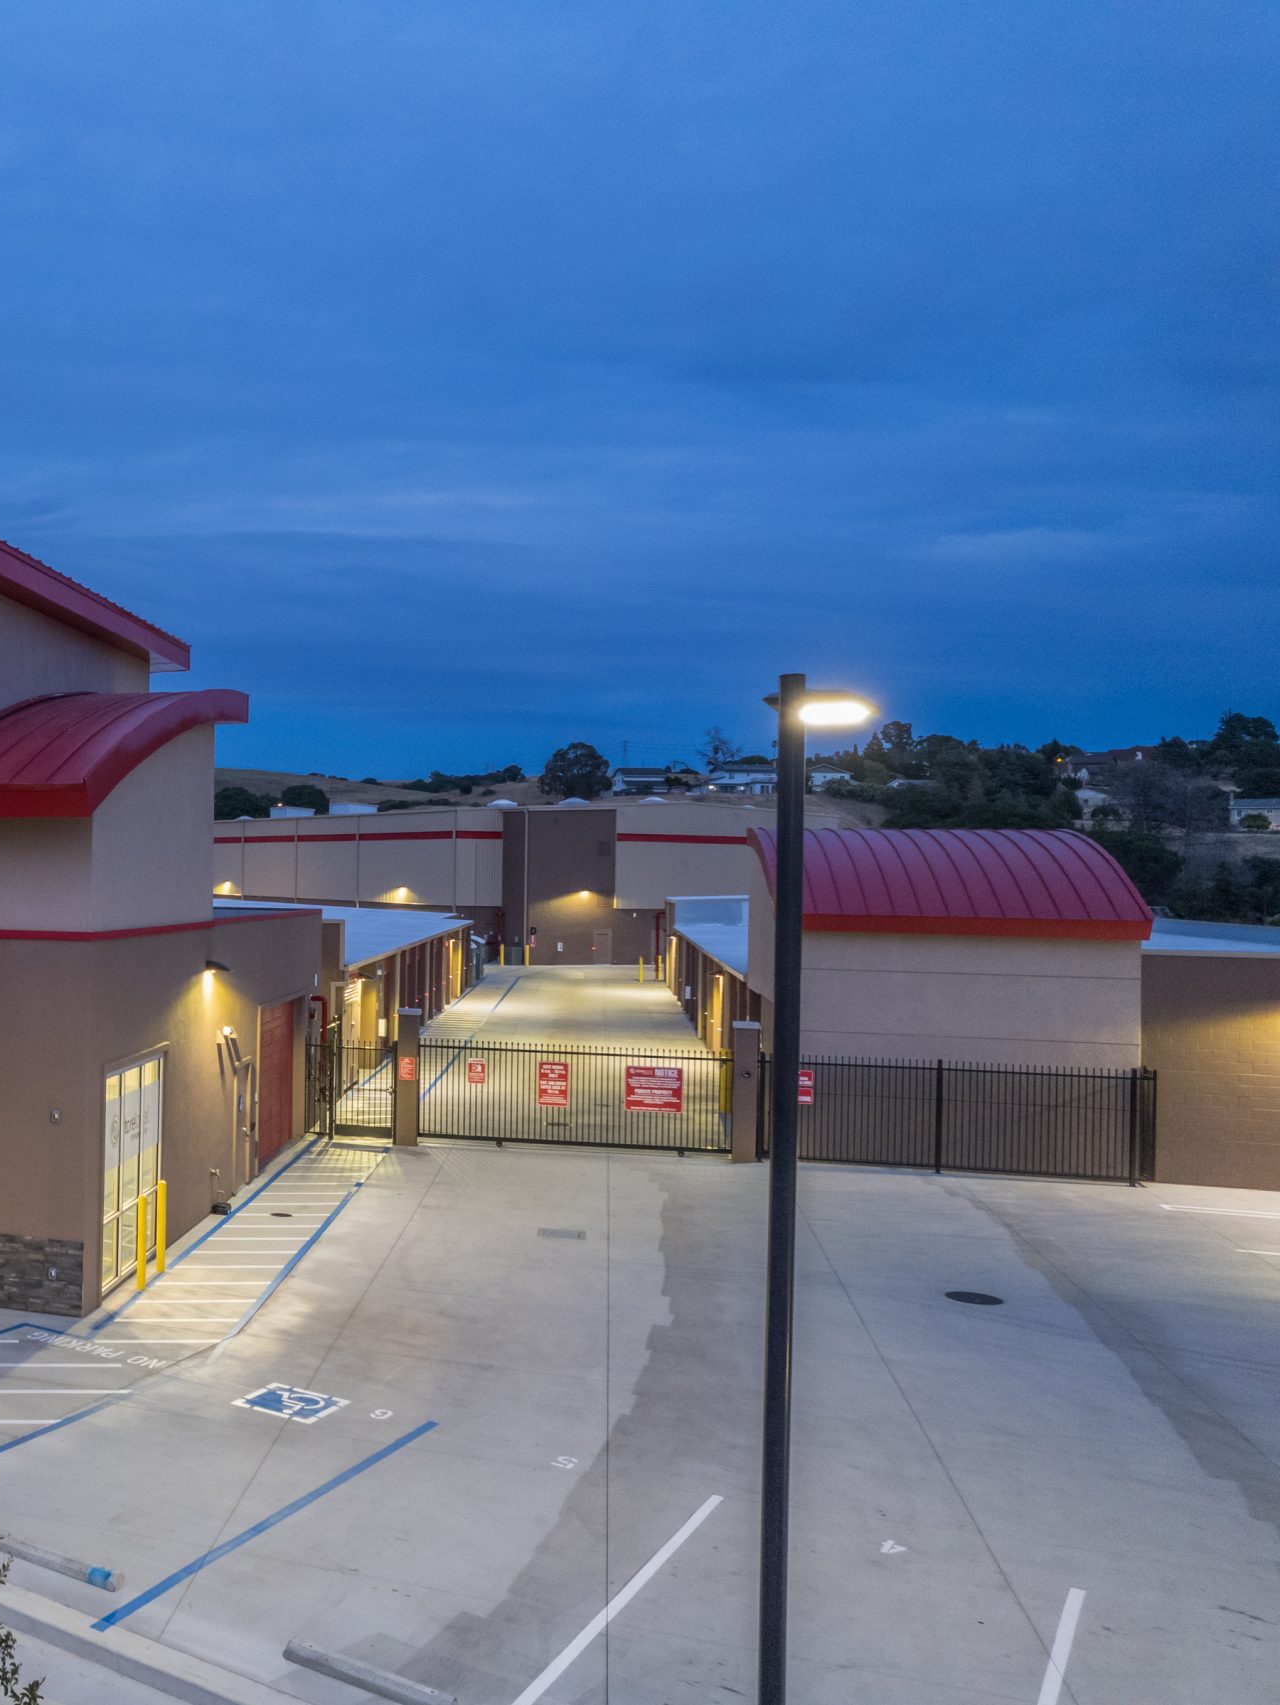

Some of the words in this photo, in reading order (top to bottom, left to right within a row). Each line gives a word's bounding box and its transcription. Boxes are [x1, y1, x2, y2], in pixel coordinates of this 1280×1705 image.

[655, 1068, 679, 1078] NOTICE
[27, 1331, 125, 1359] PARKING
[126, 1355, 166, 1369] NO
[551, 1455, 579, 1469] 5
[879, 1539, 907, 1554] 4
